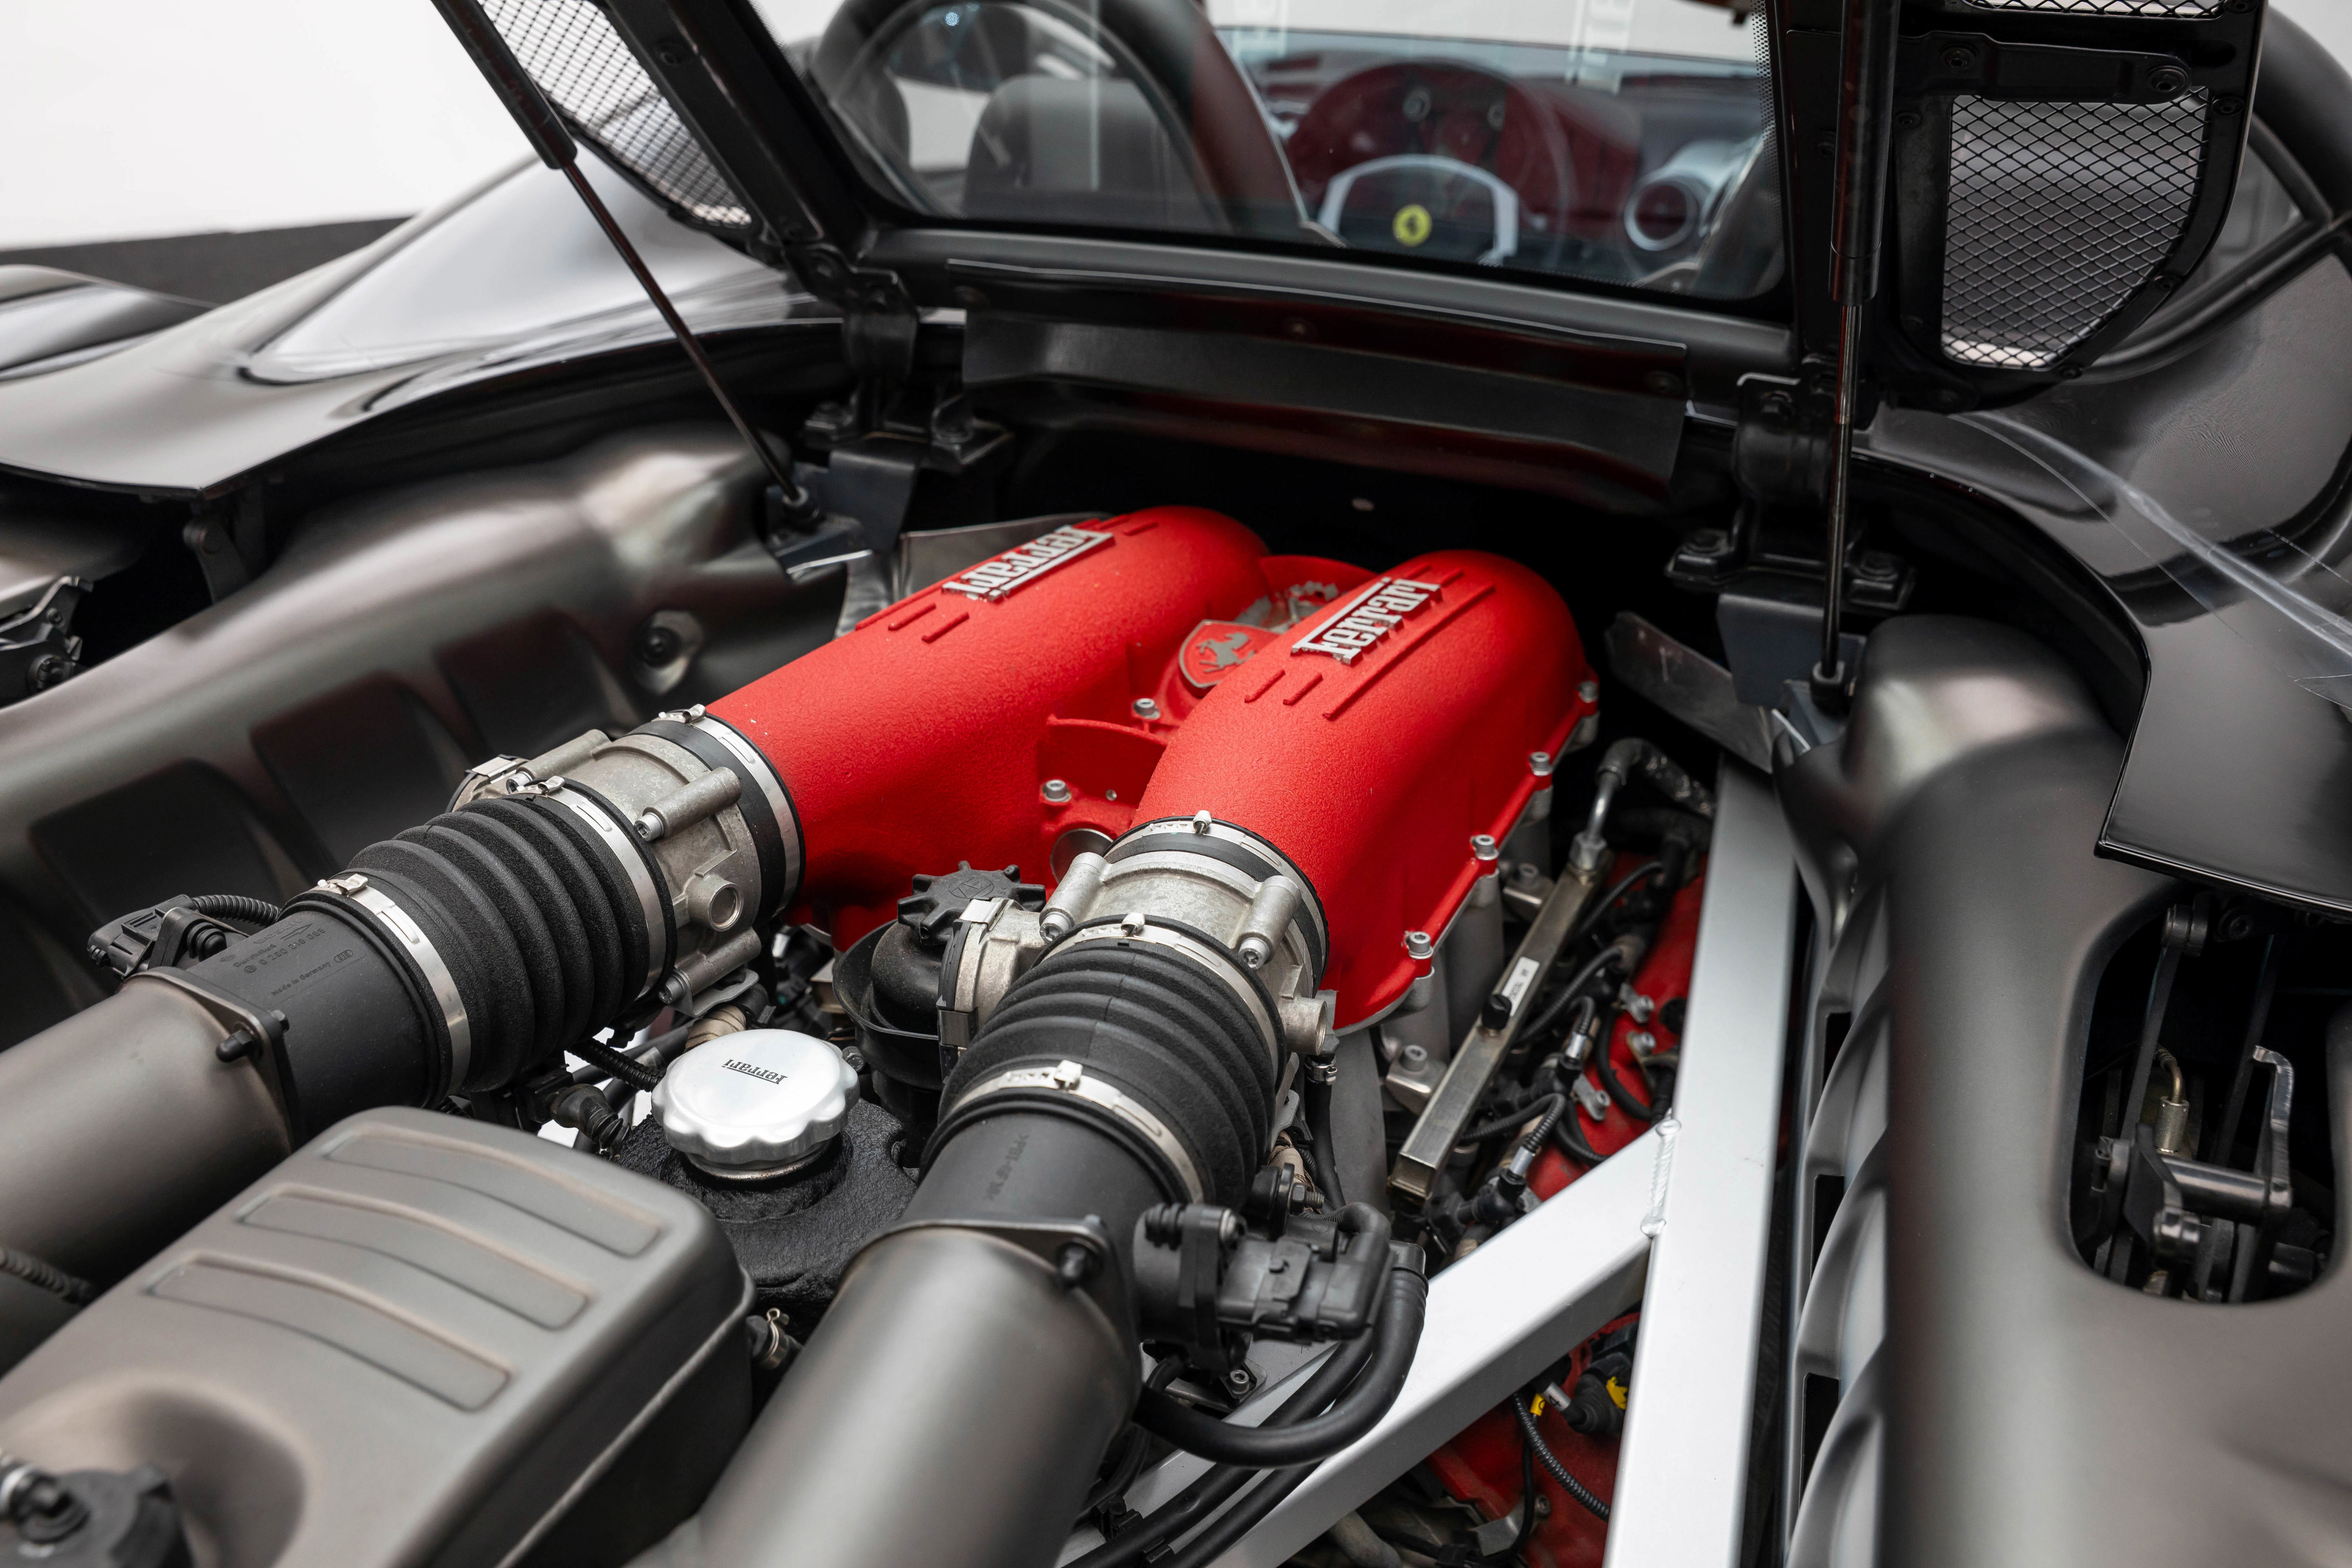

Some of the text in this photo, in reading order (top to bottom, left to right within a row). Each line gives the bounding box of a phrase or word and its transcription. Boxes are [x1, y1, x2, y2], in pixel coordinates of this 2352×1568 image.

[942, 524, 1114, 601] Ferrari
[1291, 577, 1441, 664] Ferrari
[270, 983, 292, 996] Made
[299, 962, 331, 980] Germany
[721, 1058, 788, 1085] Ferrari
